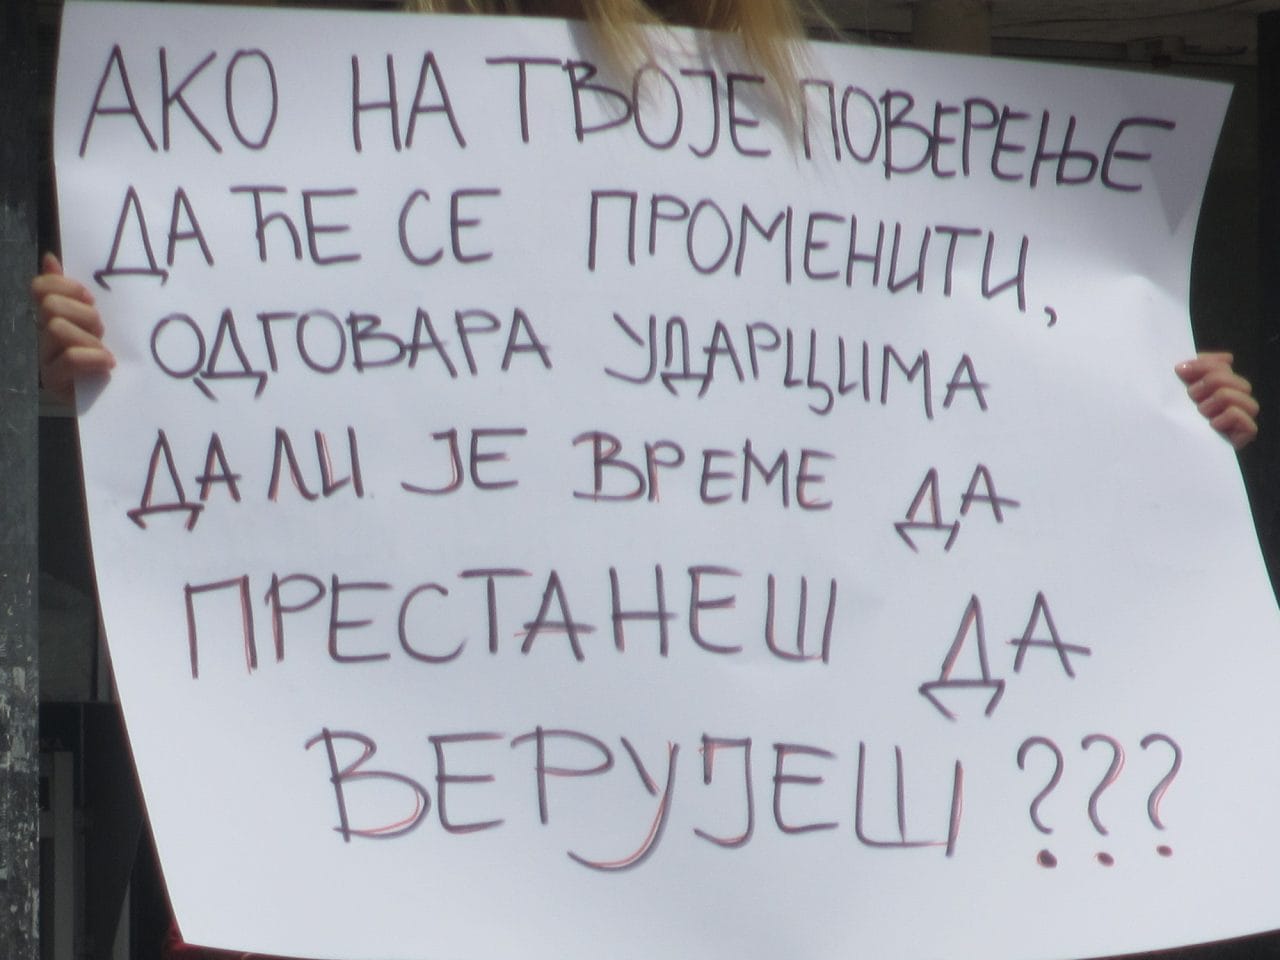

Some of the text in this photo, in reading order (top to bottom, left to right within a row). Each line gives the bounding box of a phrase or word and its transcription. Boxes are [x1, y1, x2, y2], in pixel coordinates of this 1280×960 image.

[79, 45, 1176, 192] АКО НА ТВОЈЕ ПОВЕРЕЊЕ
[399, 187, 501, 265] СЕ
[587, 190, 1057, 328] ПРОМЕНИТИ,
[150, 307, 990, 420] ОДГОВАРА УДАРЦИМА
[401, 427, 527, 496] ЈЕ
[572, 431, 837, 509] ВРЕМЕ
[893, 463, 1021, 553] ДА
[184, 563, 1092, 721] ПРЕСТАНЕШ ДА
